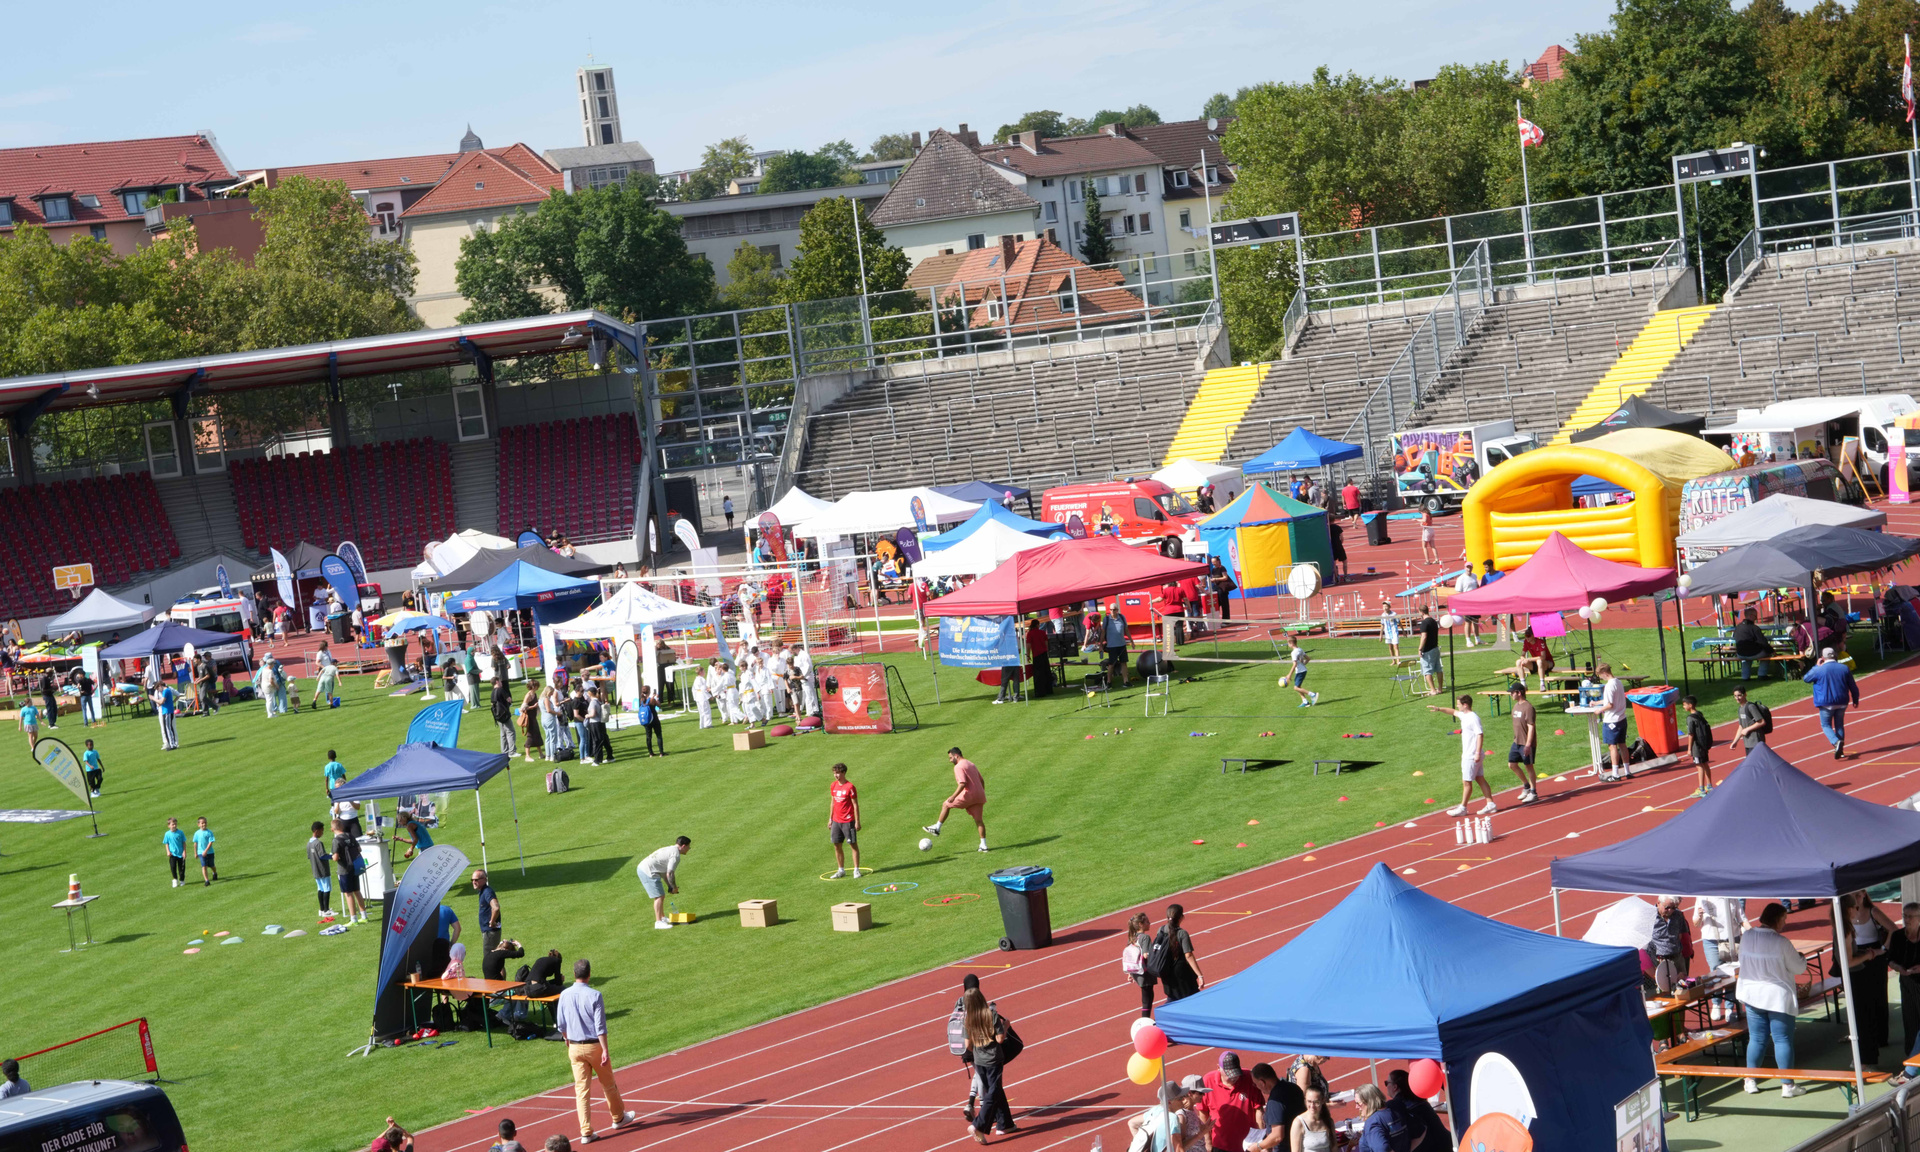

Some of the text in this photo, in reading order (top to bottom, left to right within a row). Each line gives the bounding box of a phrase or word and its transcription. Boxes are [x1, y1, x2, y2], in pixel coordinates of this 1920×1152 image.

[1680, 166, 1689, 174] 34
[1402, 432, 1459, 448] ADVENTURE
[1050, 502, 1087, 511] FEUERWEHR
[1690, 487, 1739, 516] ROTE
[406, 853, 455, 919] HOCHSCHULSPORT
[41, 1122, 105, 1152] DER CODE FÜR
